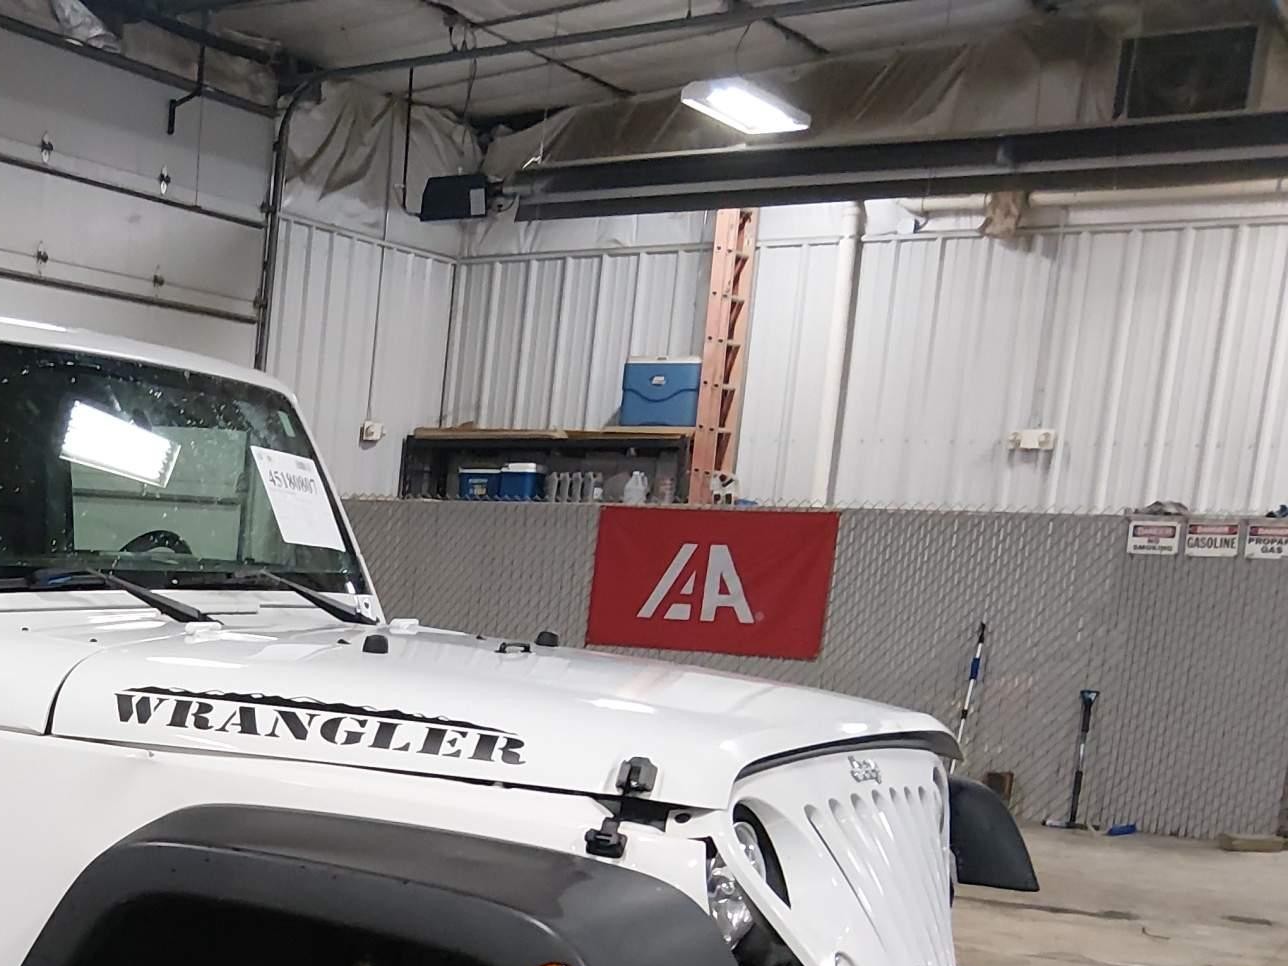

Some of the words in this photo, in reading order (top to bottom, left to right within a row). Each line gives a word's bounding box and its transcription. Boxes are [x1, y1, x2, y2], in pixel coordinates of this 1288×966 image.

[1187, 536, 1237, 549] GASOLINE
[1261, 546, 1283, 554] GAS
[114, 692, 528, 766] WRANGLER
